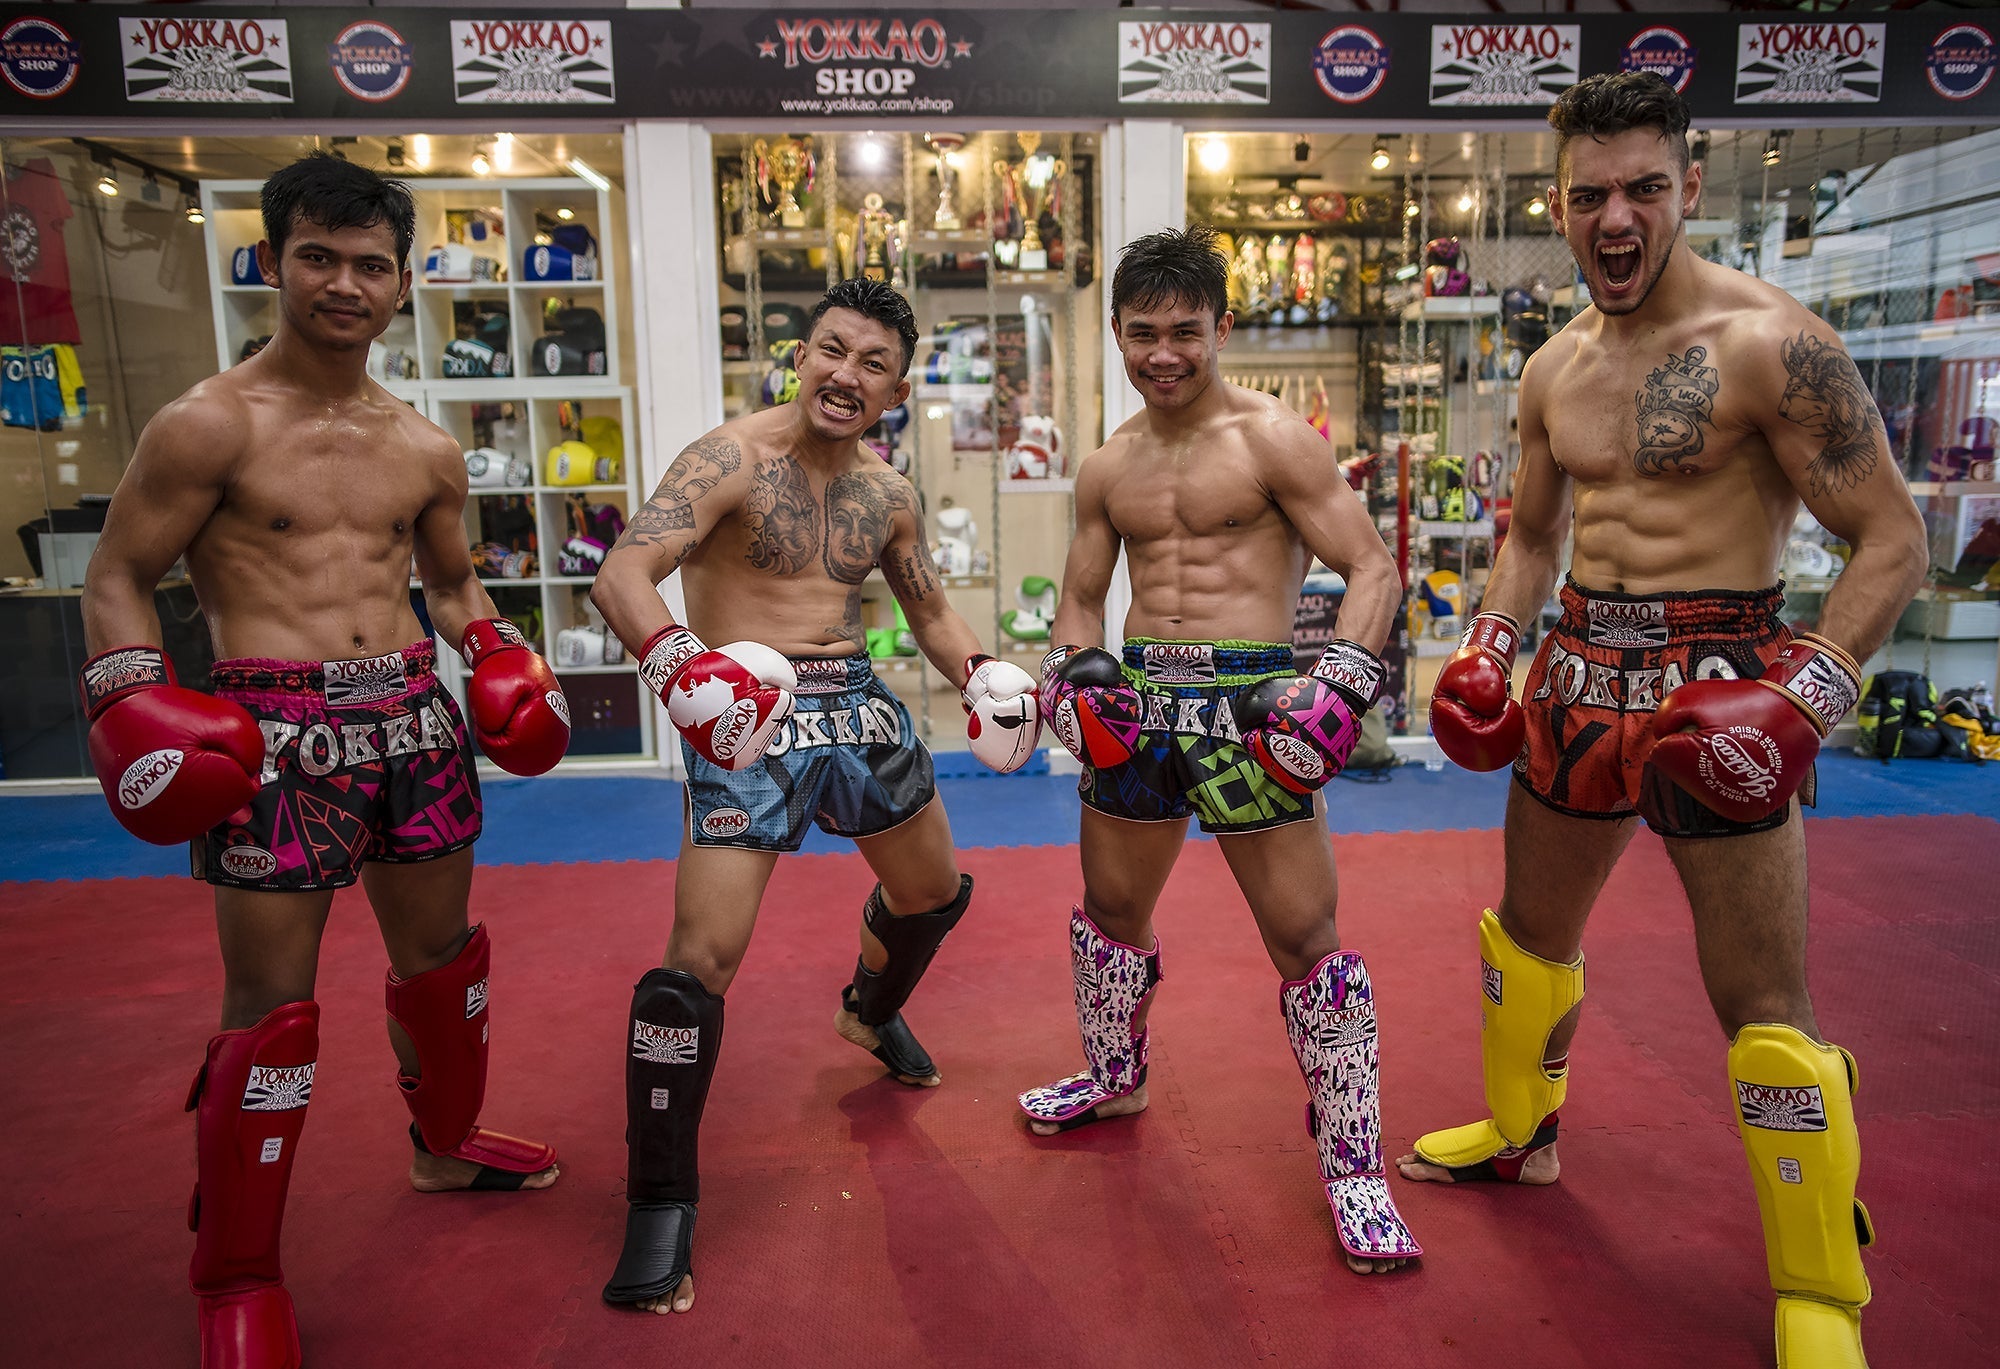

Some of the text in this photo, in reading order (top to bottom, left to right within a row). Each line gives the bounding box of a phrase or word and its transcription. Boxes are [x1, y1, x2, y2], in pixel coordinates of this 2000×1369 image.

[140, 19, 264, 55] YOKKAO
[472, 22, 590, 56] YOKKAO
[776, 19, 946, 68] YOKKAO
[1139, 24, 1249, 57] YOKKAO
[1452, 26, 1559, 59] YOKKAO
[1758, 25, 1865, 57] YOKKAO
[18, 60, 58, 71] SHOP
[353, 63, 390, 75] SHOP
[1332, 66, 1368, 77] SHOP
[1943, 64, 1978, 75] SHOP
[815, 68, 915, 95] SHOP
[781, 98, 953, 114] www.yokkao.com/shop
[1595, 602, 1651, 622] YOKKAO
[1481, 625, 1493, 642] 10 oz
[1596, 638, 1655, 647] www.yokkao.com
[1151, 645, 1202, 660] YOKKAO
[335, 656, 398, 679] YOKKAO
[656, 645, 696, 687] YOKKAO
[1154, 674, 1206, 682] www.yokkao.com
[94, 667, 157, 696] YOKKAO
[1322, 663, 1369, 695] YOKKAO
[340, 689, 399, 704] www.yokkao.com
[1801, 681, 1839, 726] OKKAO
[715, 704, 757, 757] YOKKAO
[765, 698, 901, 757] OKKAO
[1060, 706, 1079, 753] YOKKAO
[1272, 739, 1321, 779] YOKKAO
[1728, 726, 1782, 774] FIGHTER INSIDE
[121, 752, 180, 807] YOKKAO
[1699, 751, 1749, 802] BORN TO FIGHT
[709, 813, 744, 830] YOKKAO
[228, 853, 269, 870] YOKKAO
[1326, 1004, 1371, 1027] YOKKAO
[640, 1023, 692, 1043] YOKKAO
[258, 1065, 313, 1085] YOKKAO
[1741, 1084, 1811, 1106] YOKKAO
